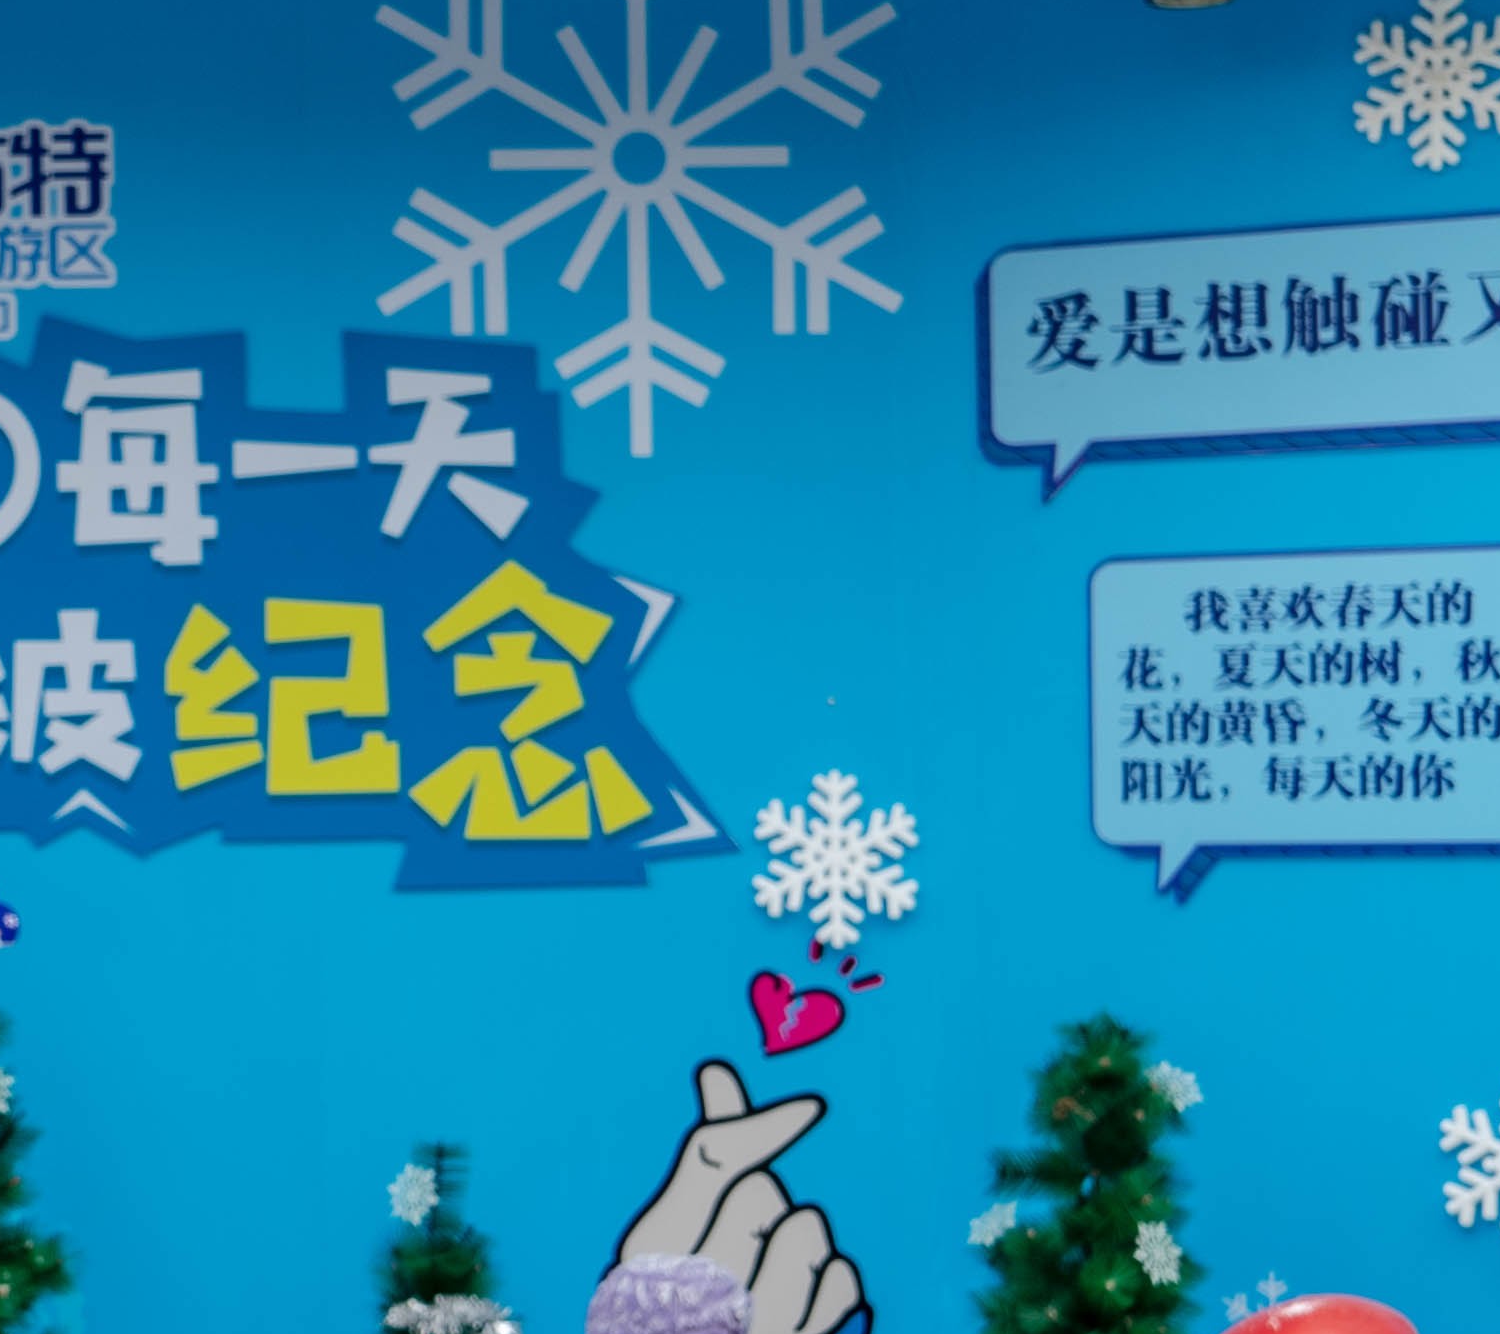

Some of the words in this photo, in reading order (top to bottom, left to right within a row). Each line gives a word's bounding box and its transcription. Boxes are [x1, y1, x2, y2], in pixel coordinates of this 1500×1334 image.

[1182, 580, 1475, 635] 我喜欢春天的
